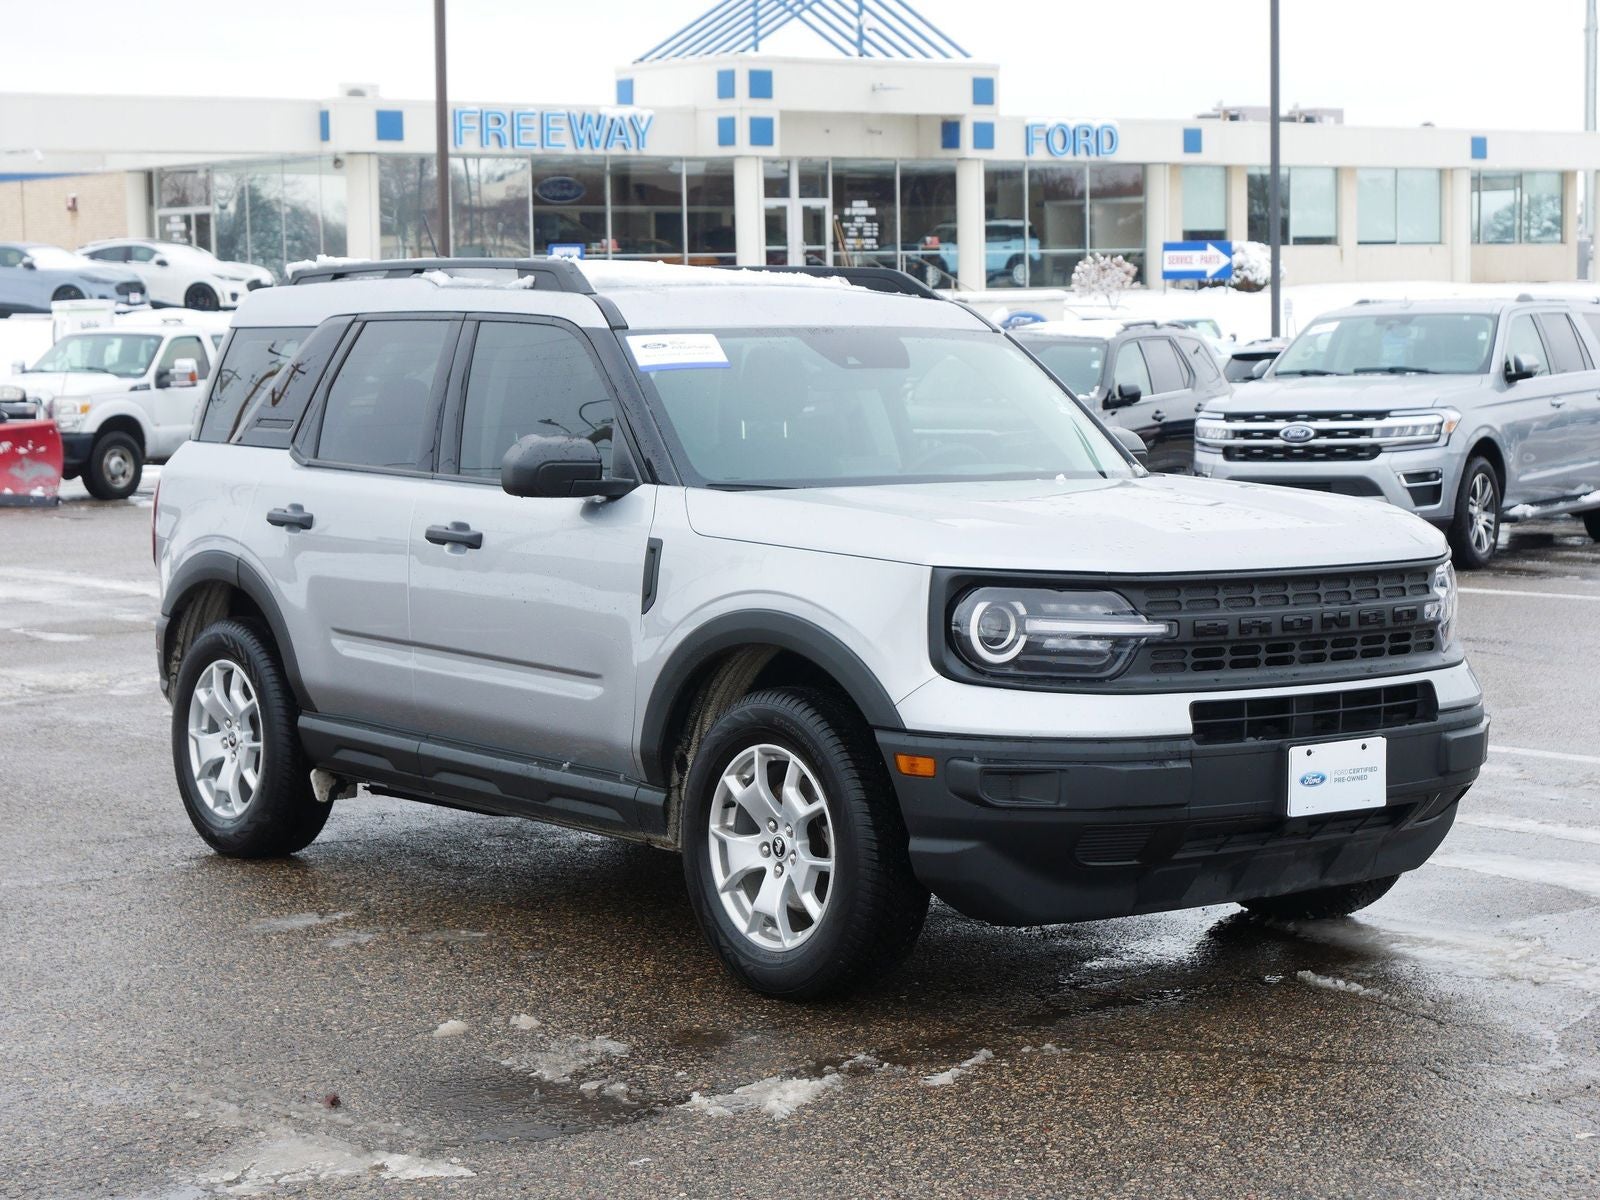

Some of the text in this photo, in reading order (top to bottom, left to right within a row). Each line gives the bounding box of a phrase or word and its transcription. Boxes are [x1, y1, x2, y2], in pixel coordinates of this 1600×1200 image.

[453, 107, 1119, 157] FREEWAY FORD
[1168, 254, 1194, 265] SERVICE
[1199, 254, 1221, 265] PARTS
[1193, 605, 1418, 637] BRONCO
[1349, 766, 1378, 775] CERTIFIED
[1334, 775, 1368, 783] PRE-OWNED
